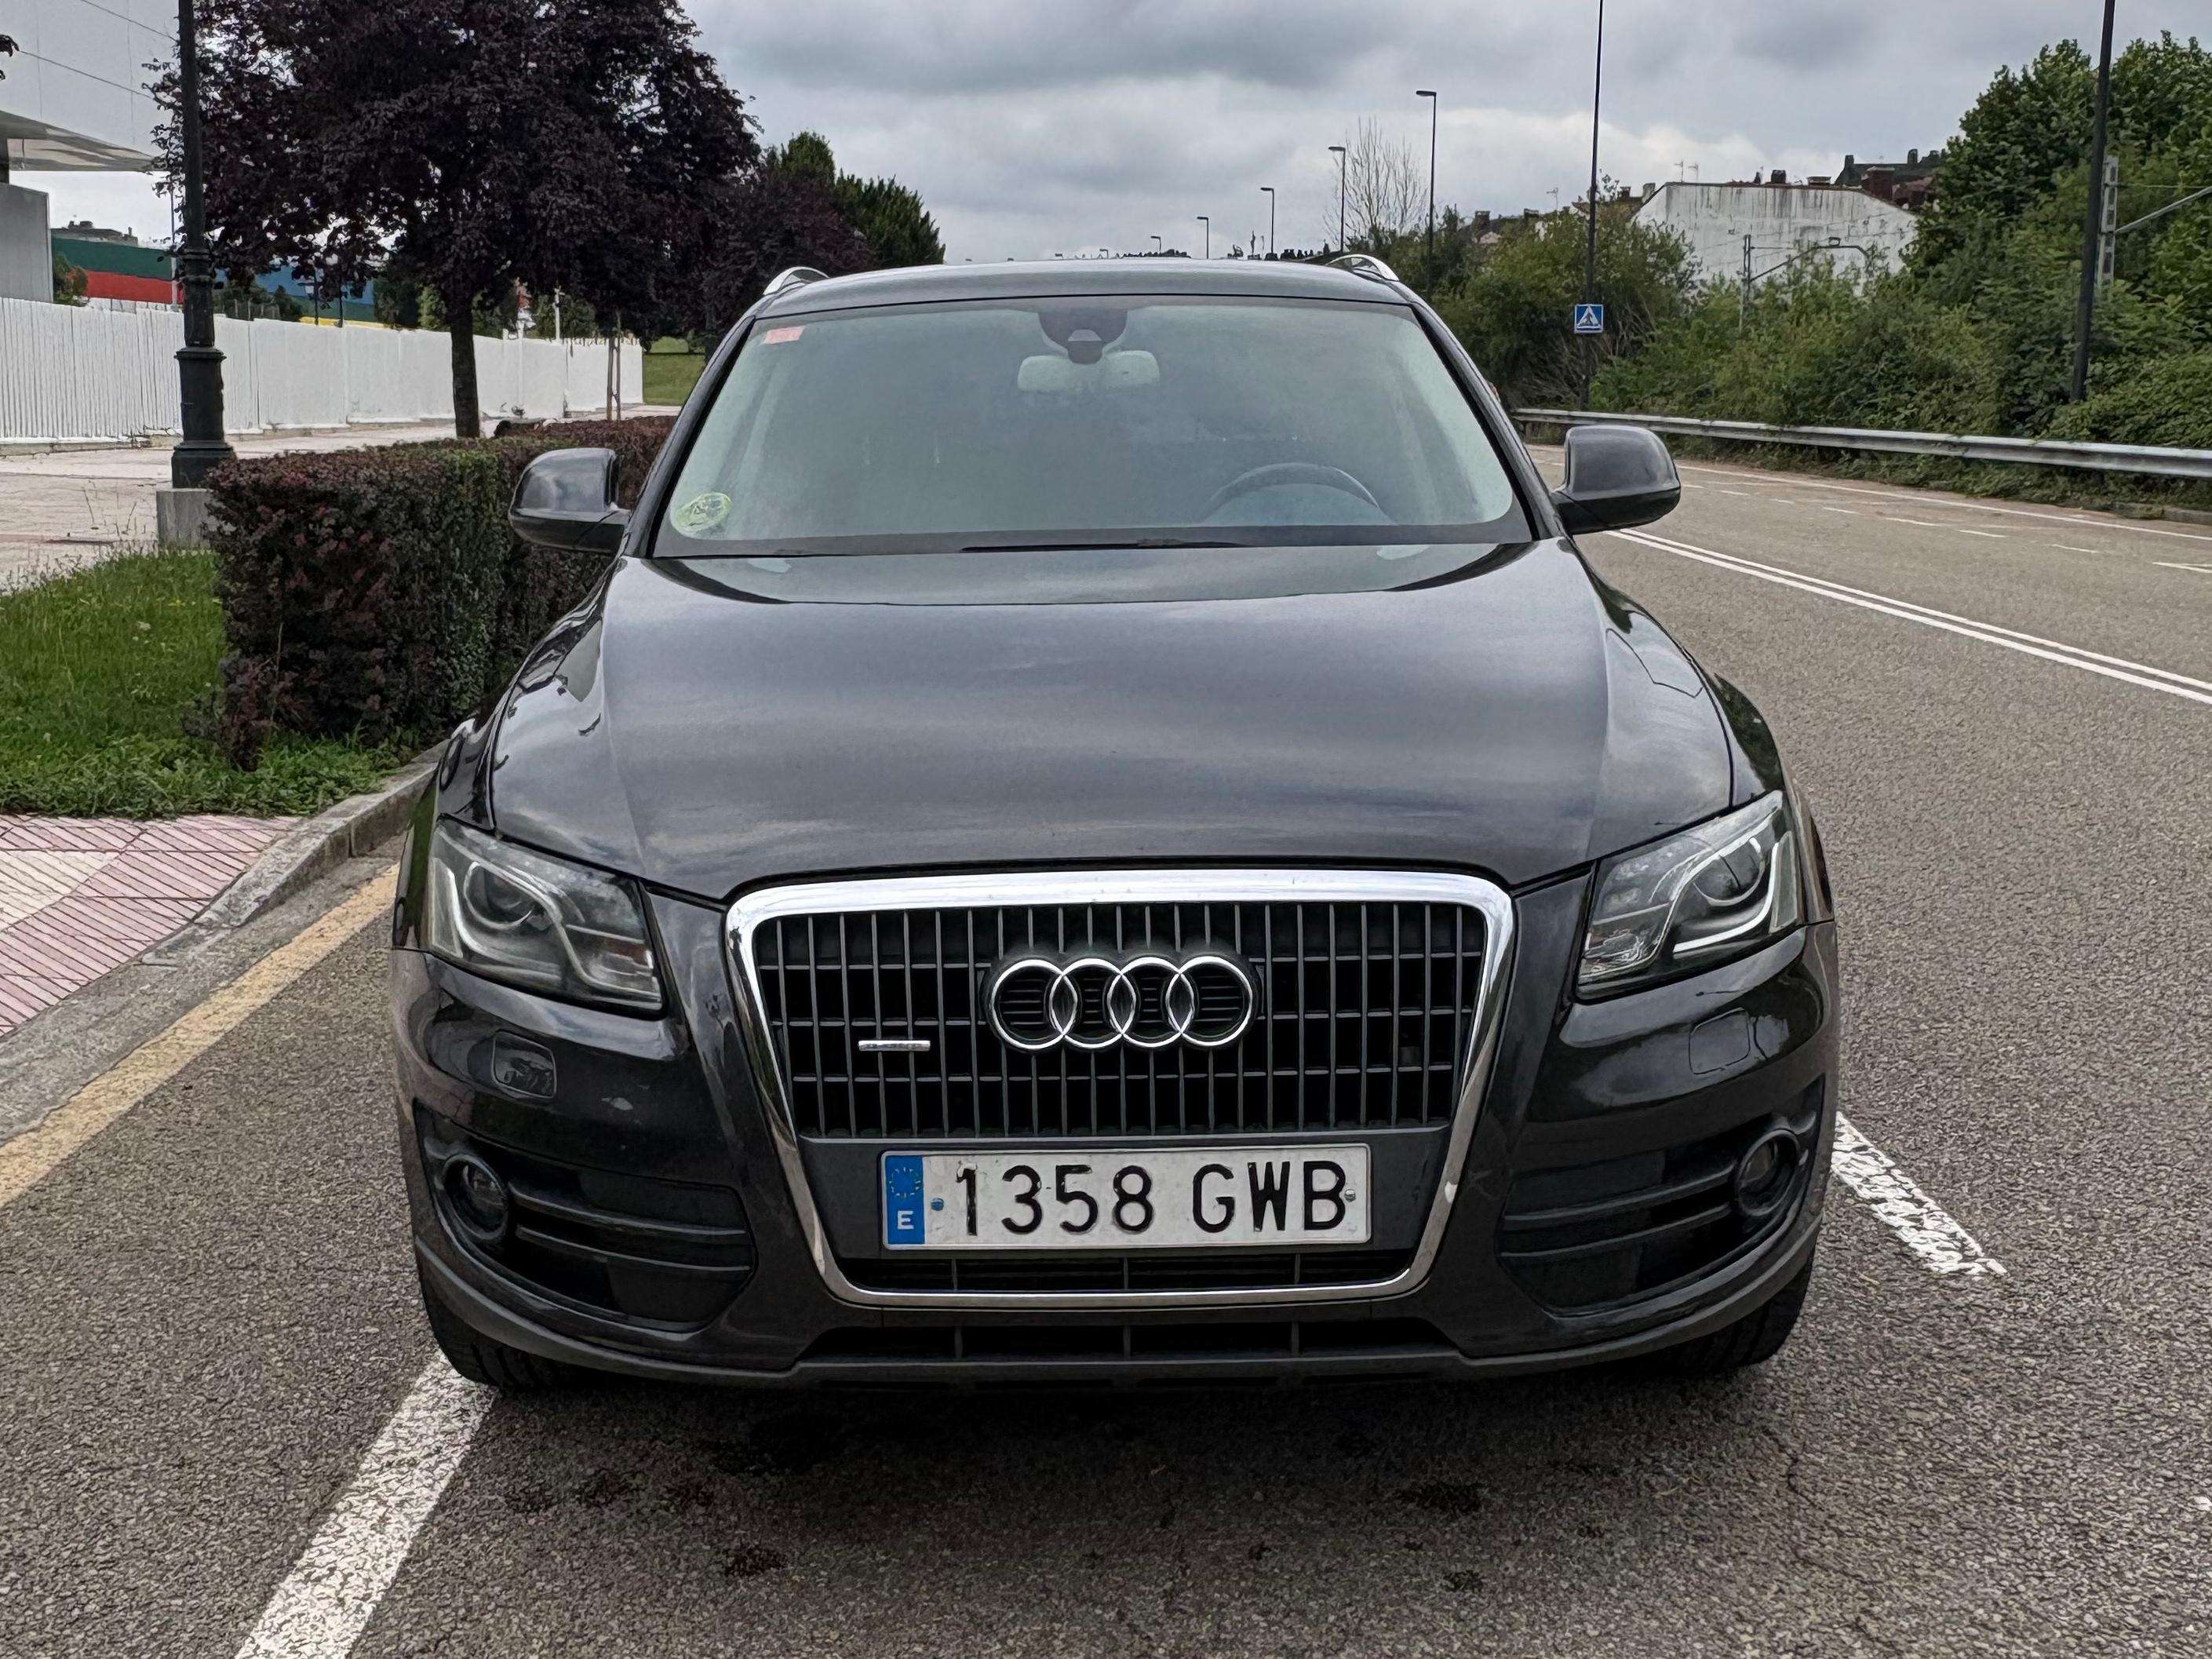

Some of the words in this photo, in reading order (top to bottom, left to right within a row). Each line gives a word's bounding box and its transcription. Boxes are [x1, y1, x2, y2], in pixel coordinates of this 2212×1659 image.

[897, 1210, 914, 1230] E
[956, 1163, 1154, 1236] 1358
[1192, 1161, 1347, 1233] GWB
